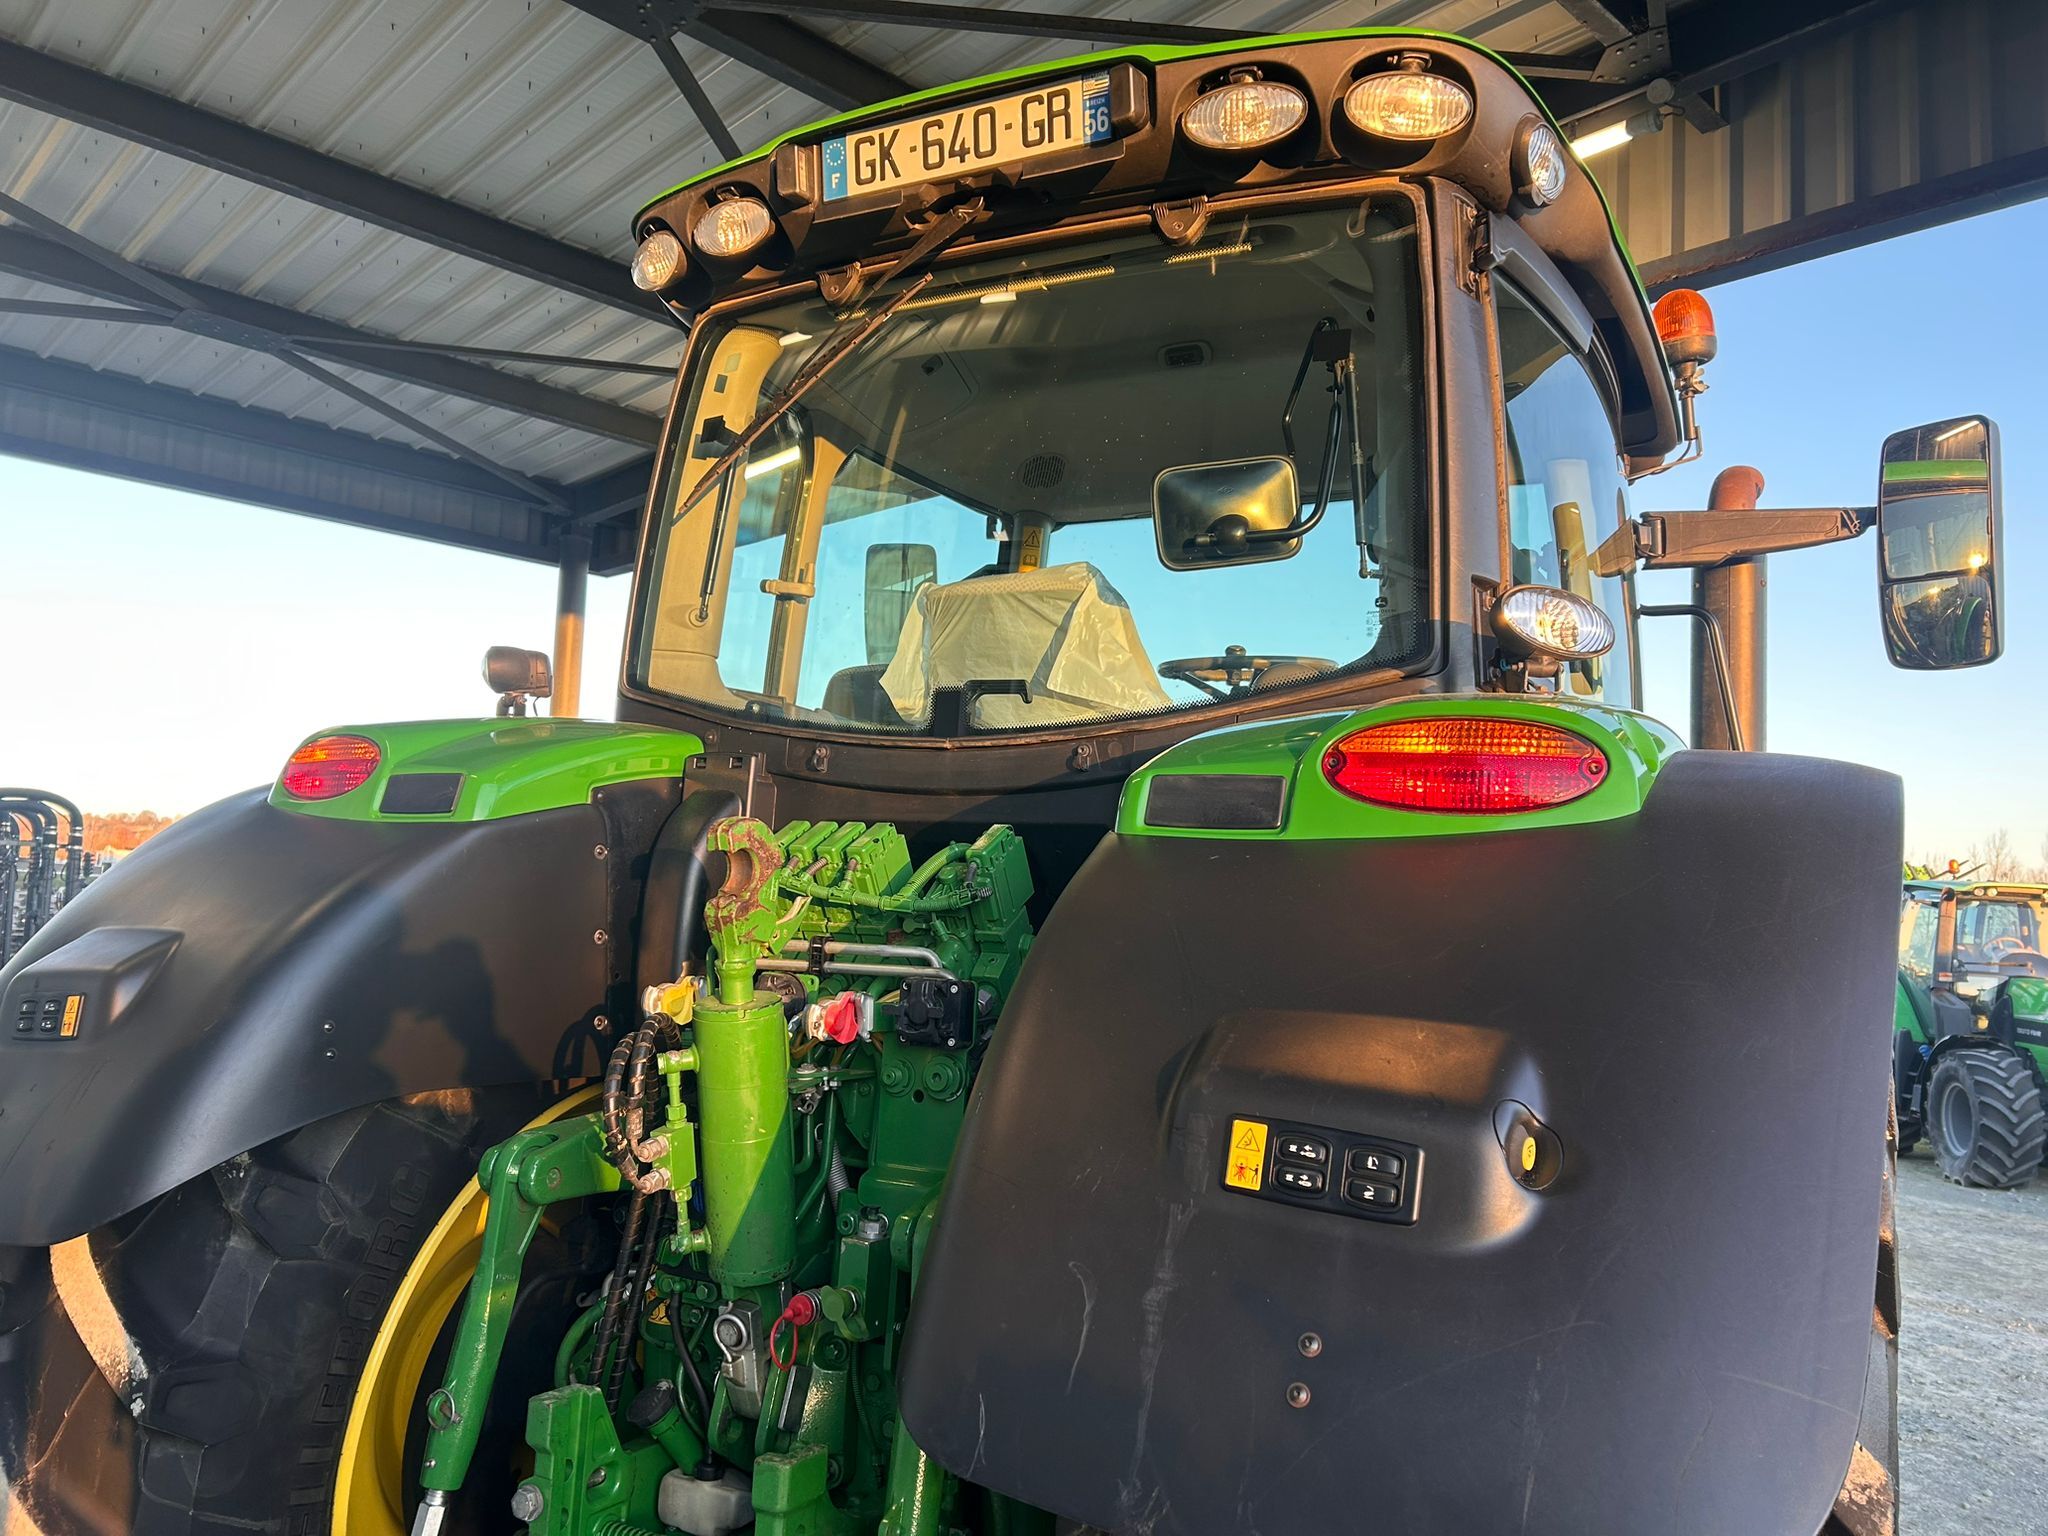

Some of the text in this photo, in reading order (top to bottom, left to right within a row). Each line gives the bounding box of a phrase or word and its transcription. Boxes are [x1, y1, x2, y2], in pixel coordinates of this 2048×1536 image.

[1084, 106, 1109, 136] 56
[854, 87, 1072, 186] GK-640-GR
[831, 172, 841, 189] F
